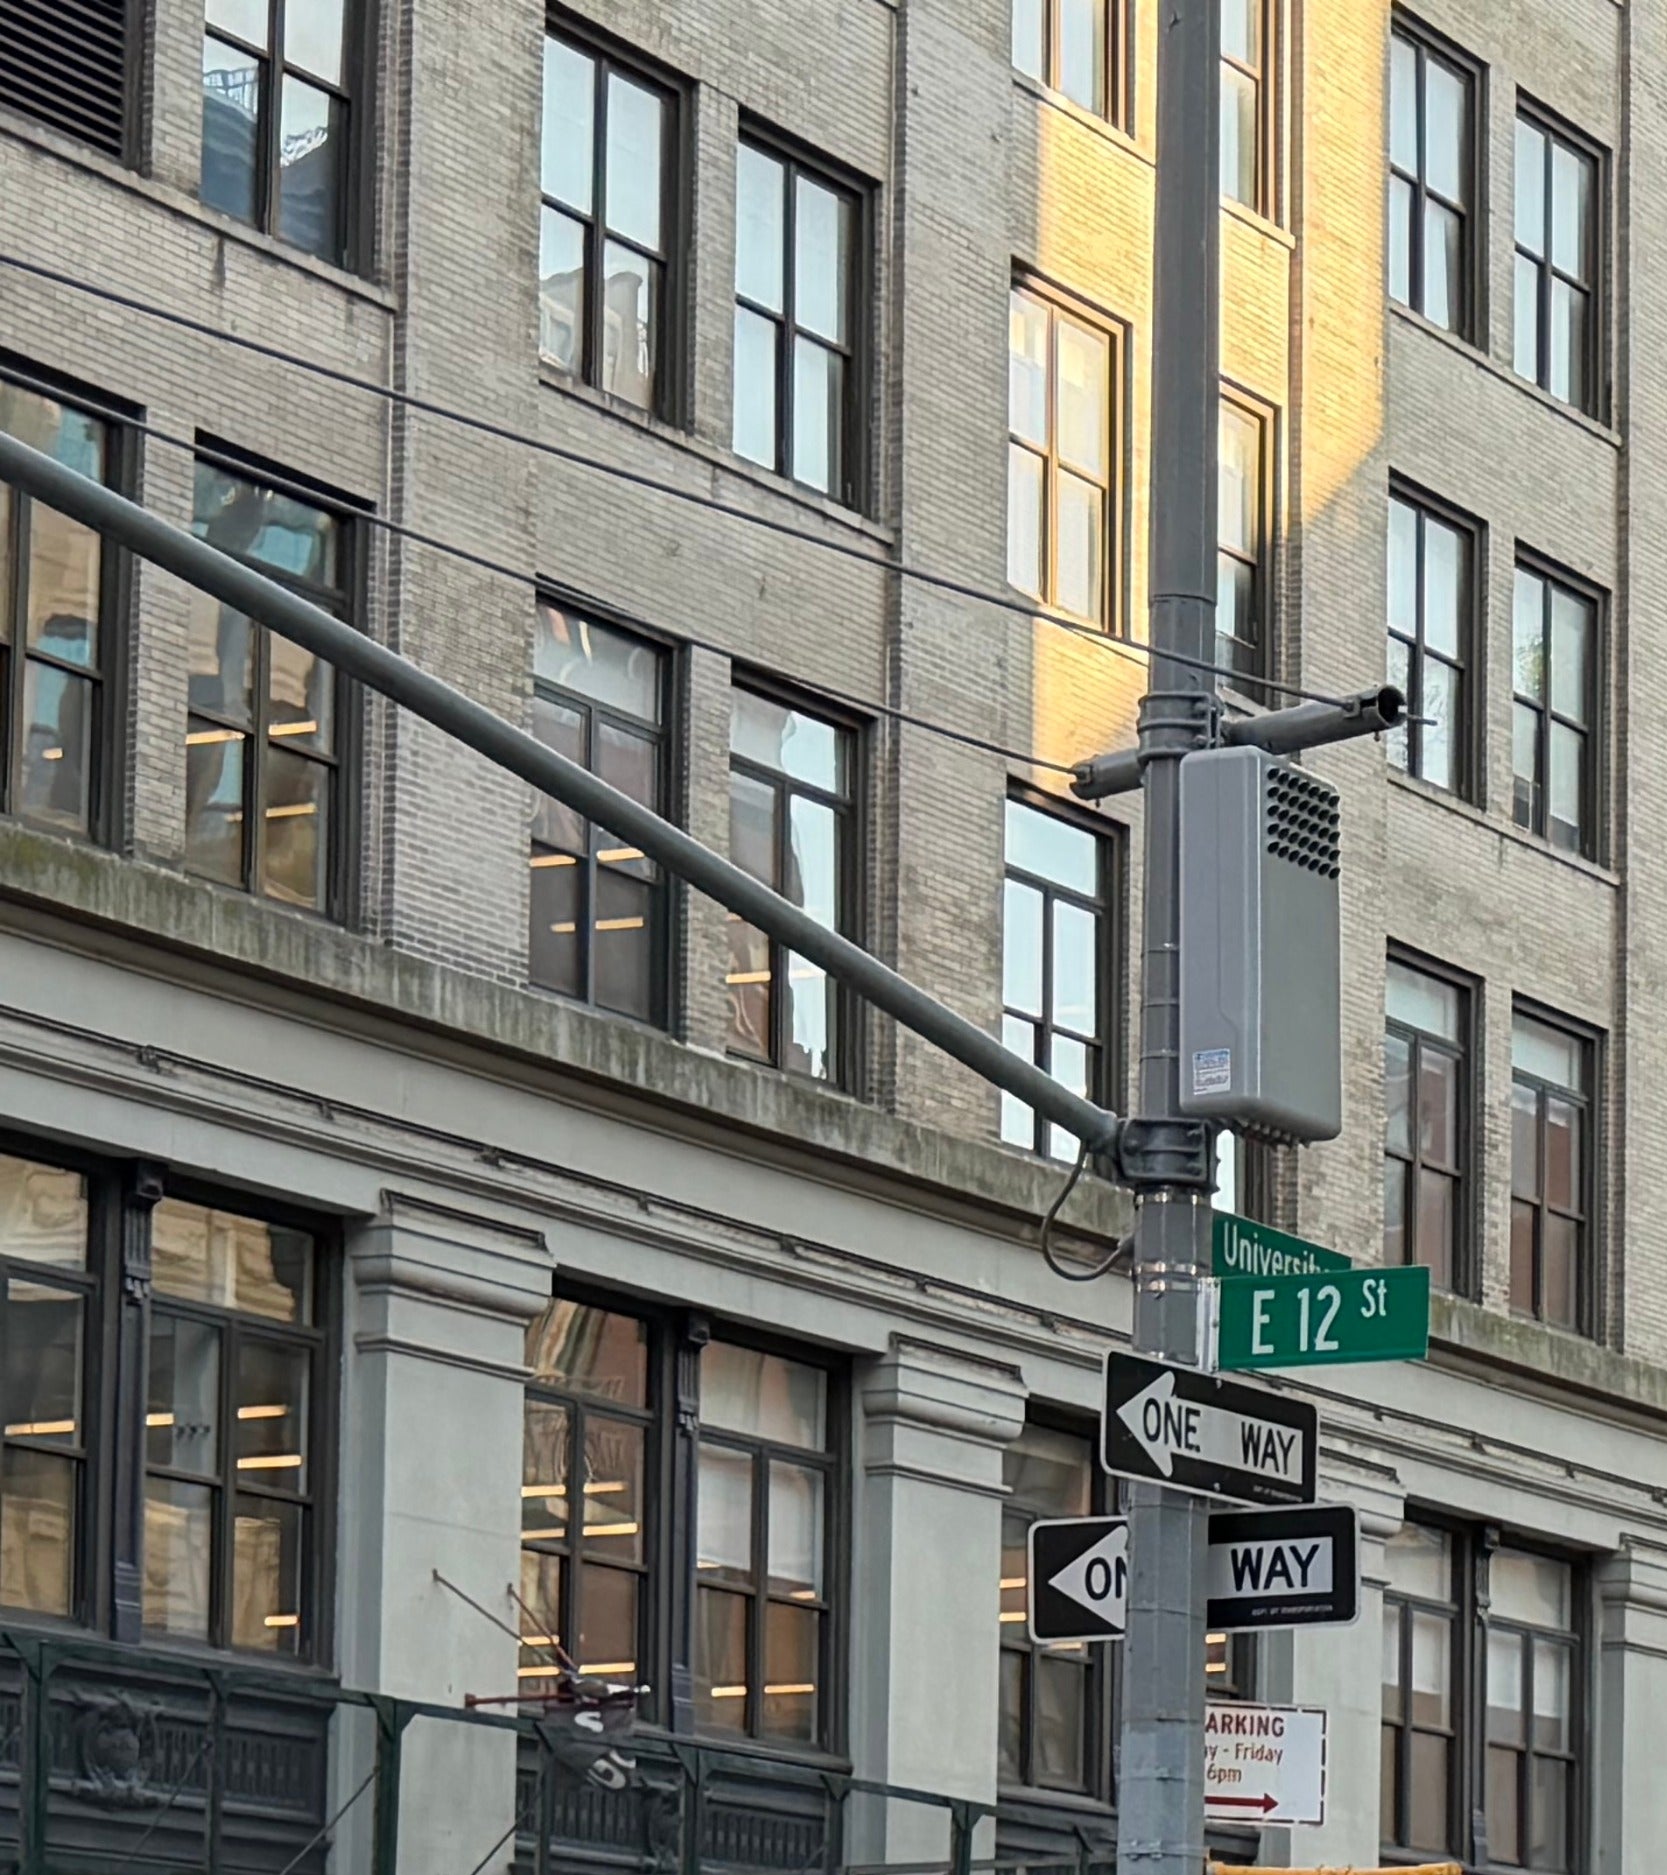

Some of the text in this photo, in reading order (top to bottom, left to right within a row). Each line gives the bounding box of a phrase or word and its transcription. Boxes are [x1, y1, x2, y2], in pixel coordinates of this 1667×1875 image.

[1224, 1222, 1331, 1276] Universit
[1252, 1278, 1387, 1355] E 12 St
[1143, 1397, 1296, 1475] ONE WAY
[1230, 1544, 1320, 1592] WAY
[1205, 1712, 1284, 1737] ARKING
[1235, 1743, 1283, 1766] Friday
